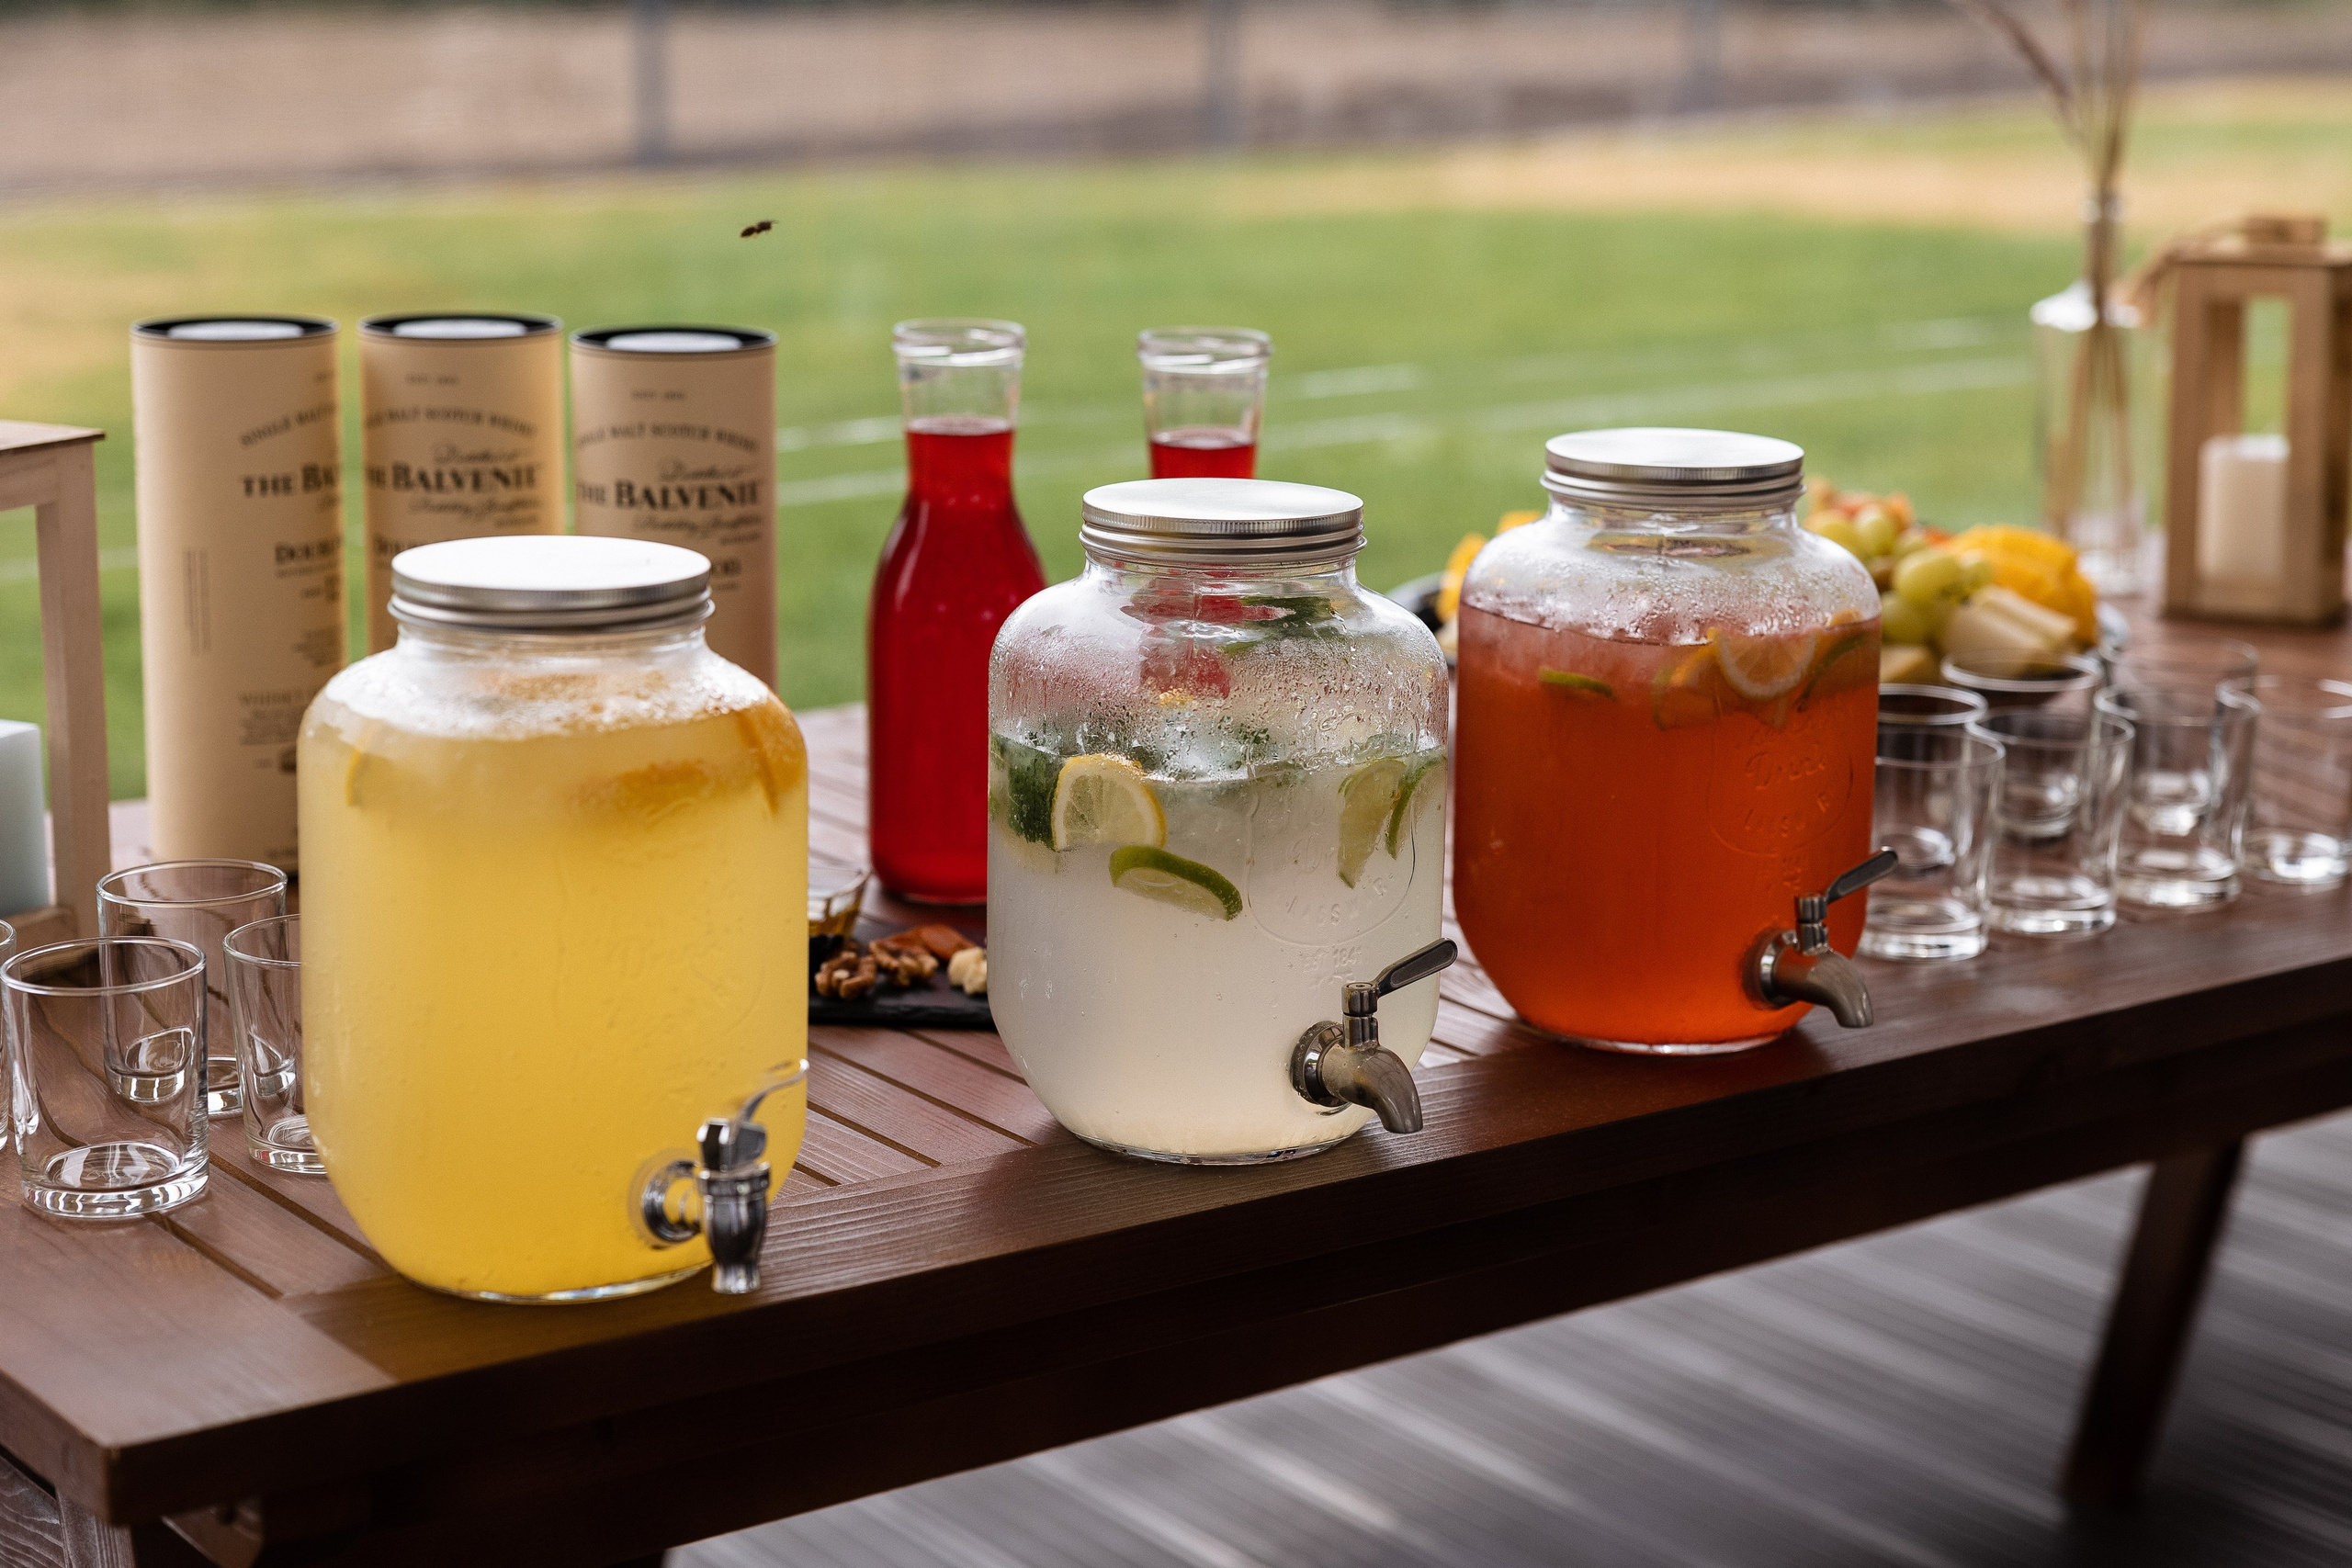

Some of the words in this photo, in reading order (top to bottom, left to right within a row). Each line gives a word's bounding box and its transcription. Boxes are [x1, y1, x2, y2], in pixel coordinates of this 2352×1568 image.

[240, 473, 296, 497] THE
[391, 461, 544, 494] BALVENIE
[615, 478, 763, 511] BALVENIE
